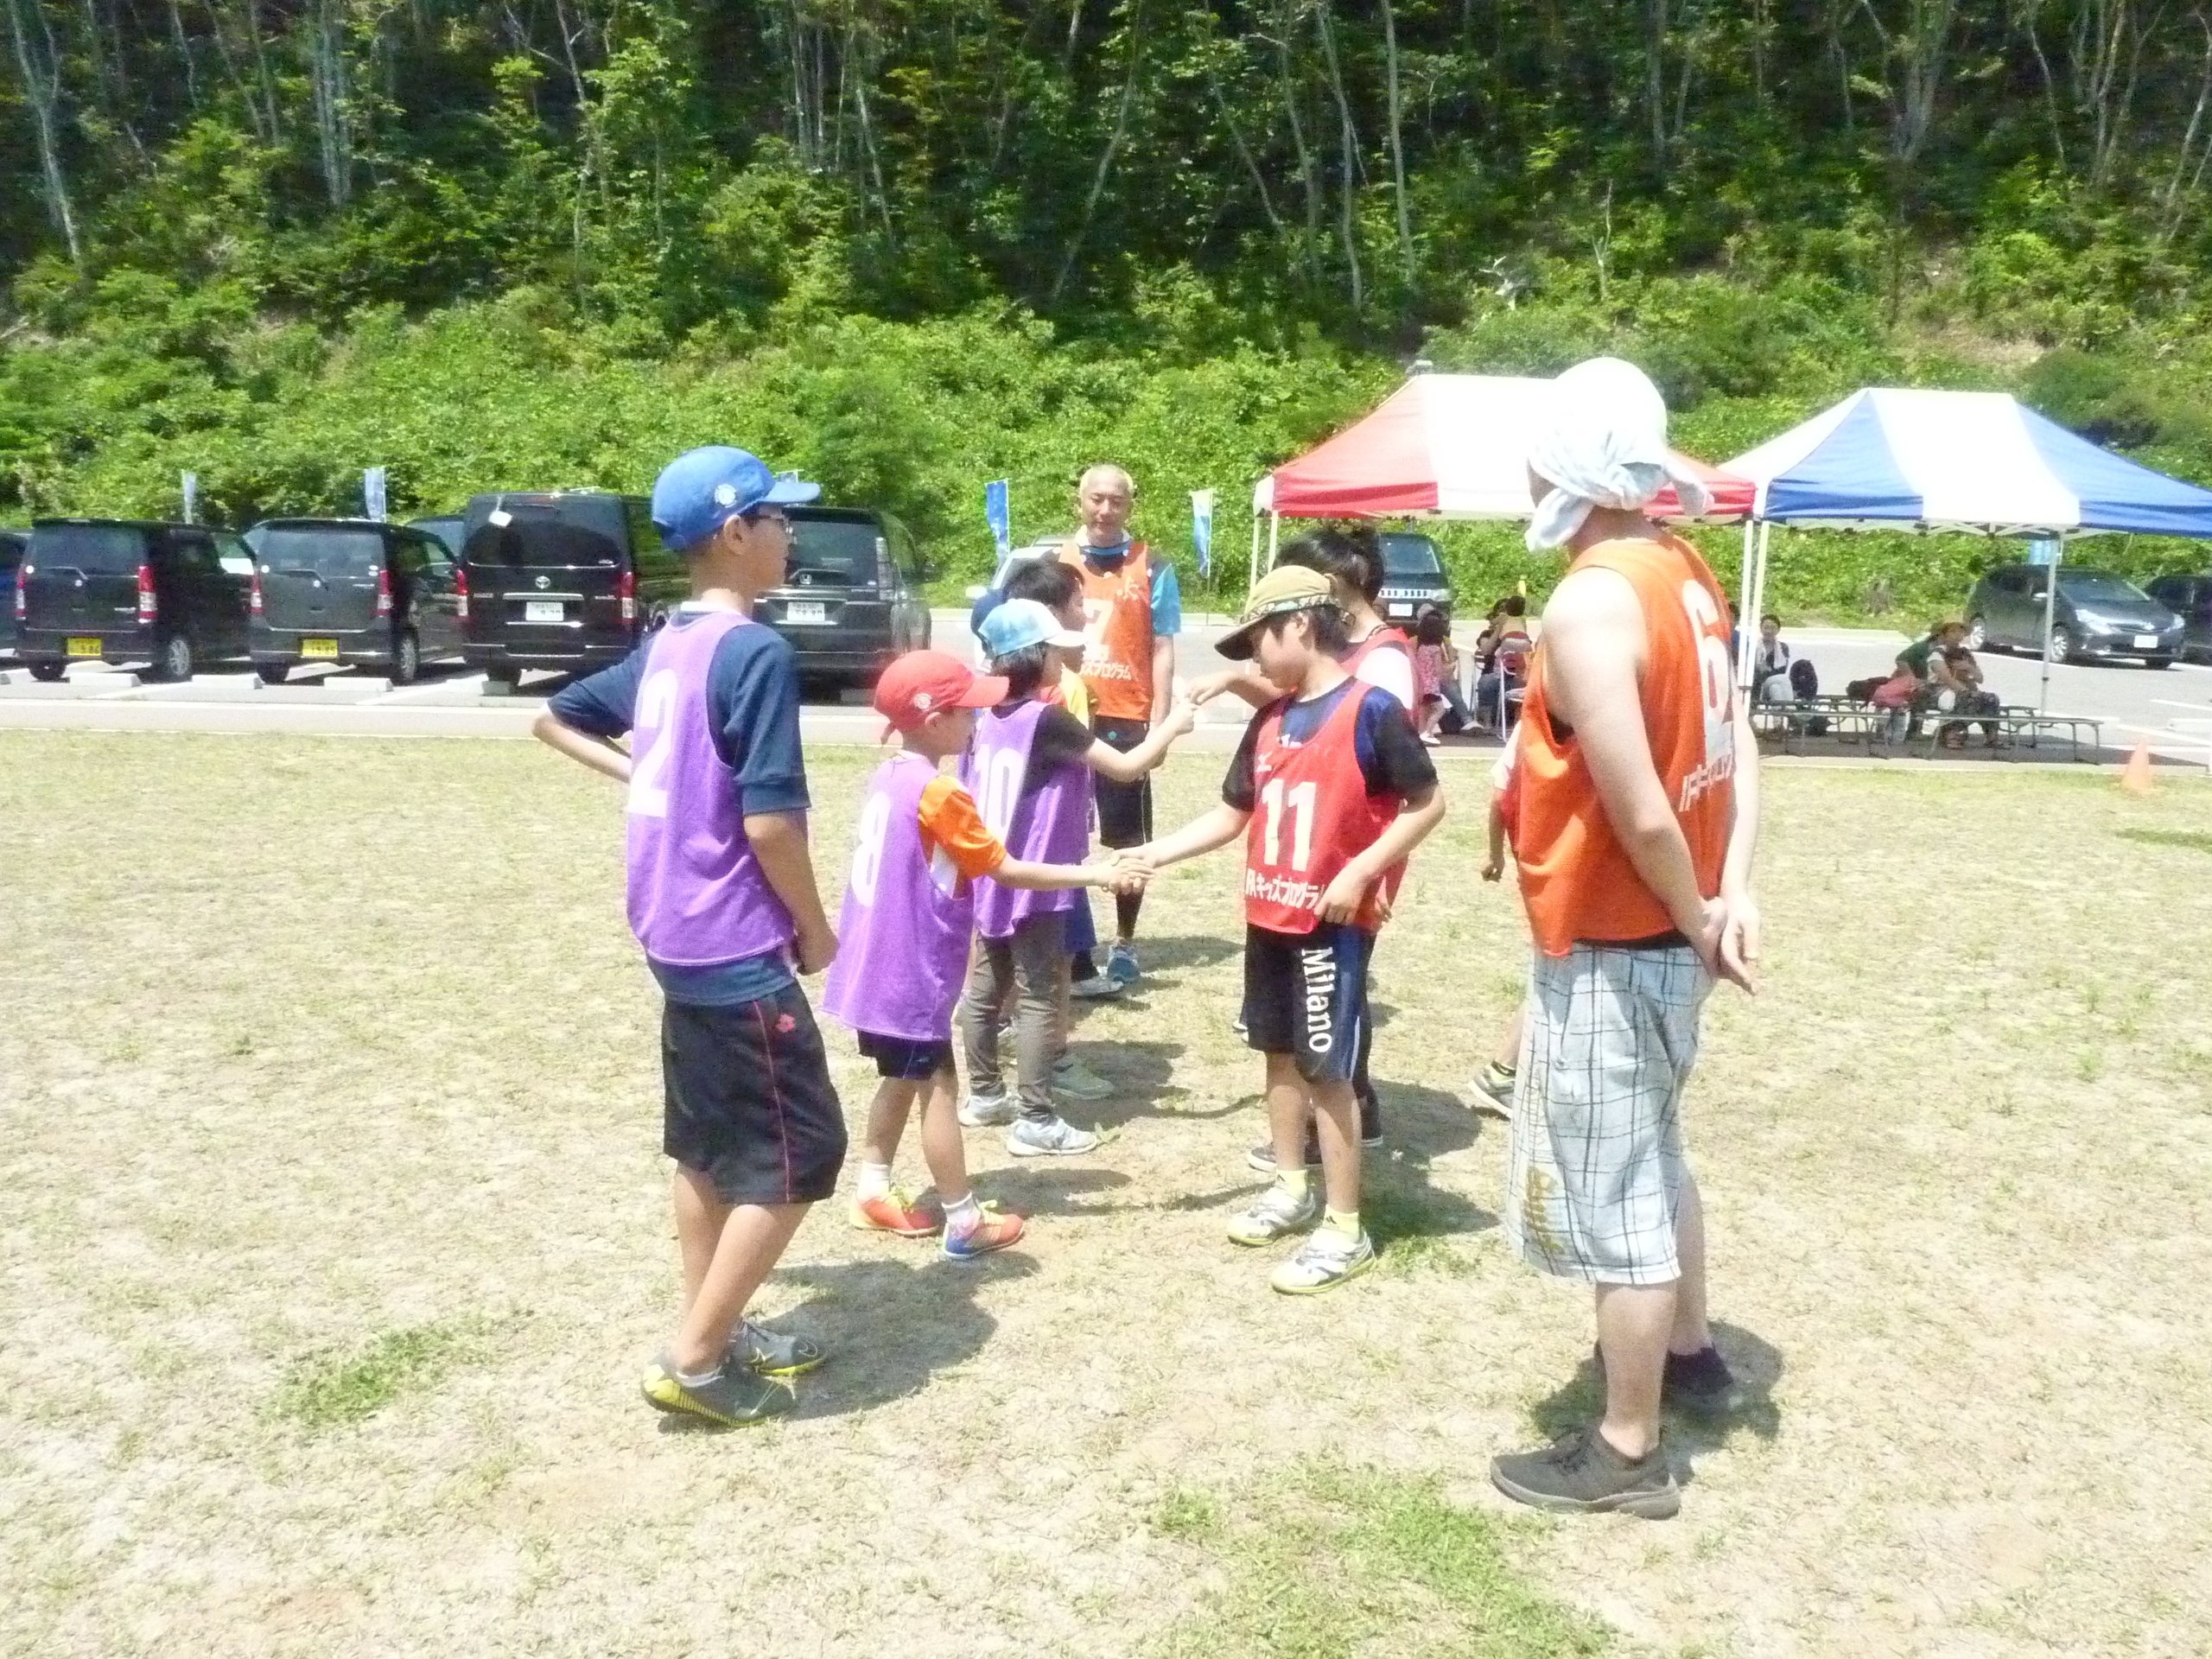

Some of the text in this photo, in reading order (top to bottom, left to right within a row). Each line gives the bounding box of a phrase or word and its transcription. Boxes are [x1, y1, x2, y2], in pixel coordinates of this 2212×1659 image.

[1682, 580, 1732, 722] 6
[628, 668, 677, 818] 2
[973, 743, 1015, 843] 10
[850, 791, 891, 907] 8
[1262, 779, 1316, 871] 11
[1301, 947, 1336, 1053] Milano
